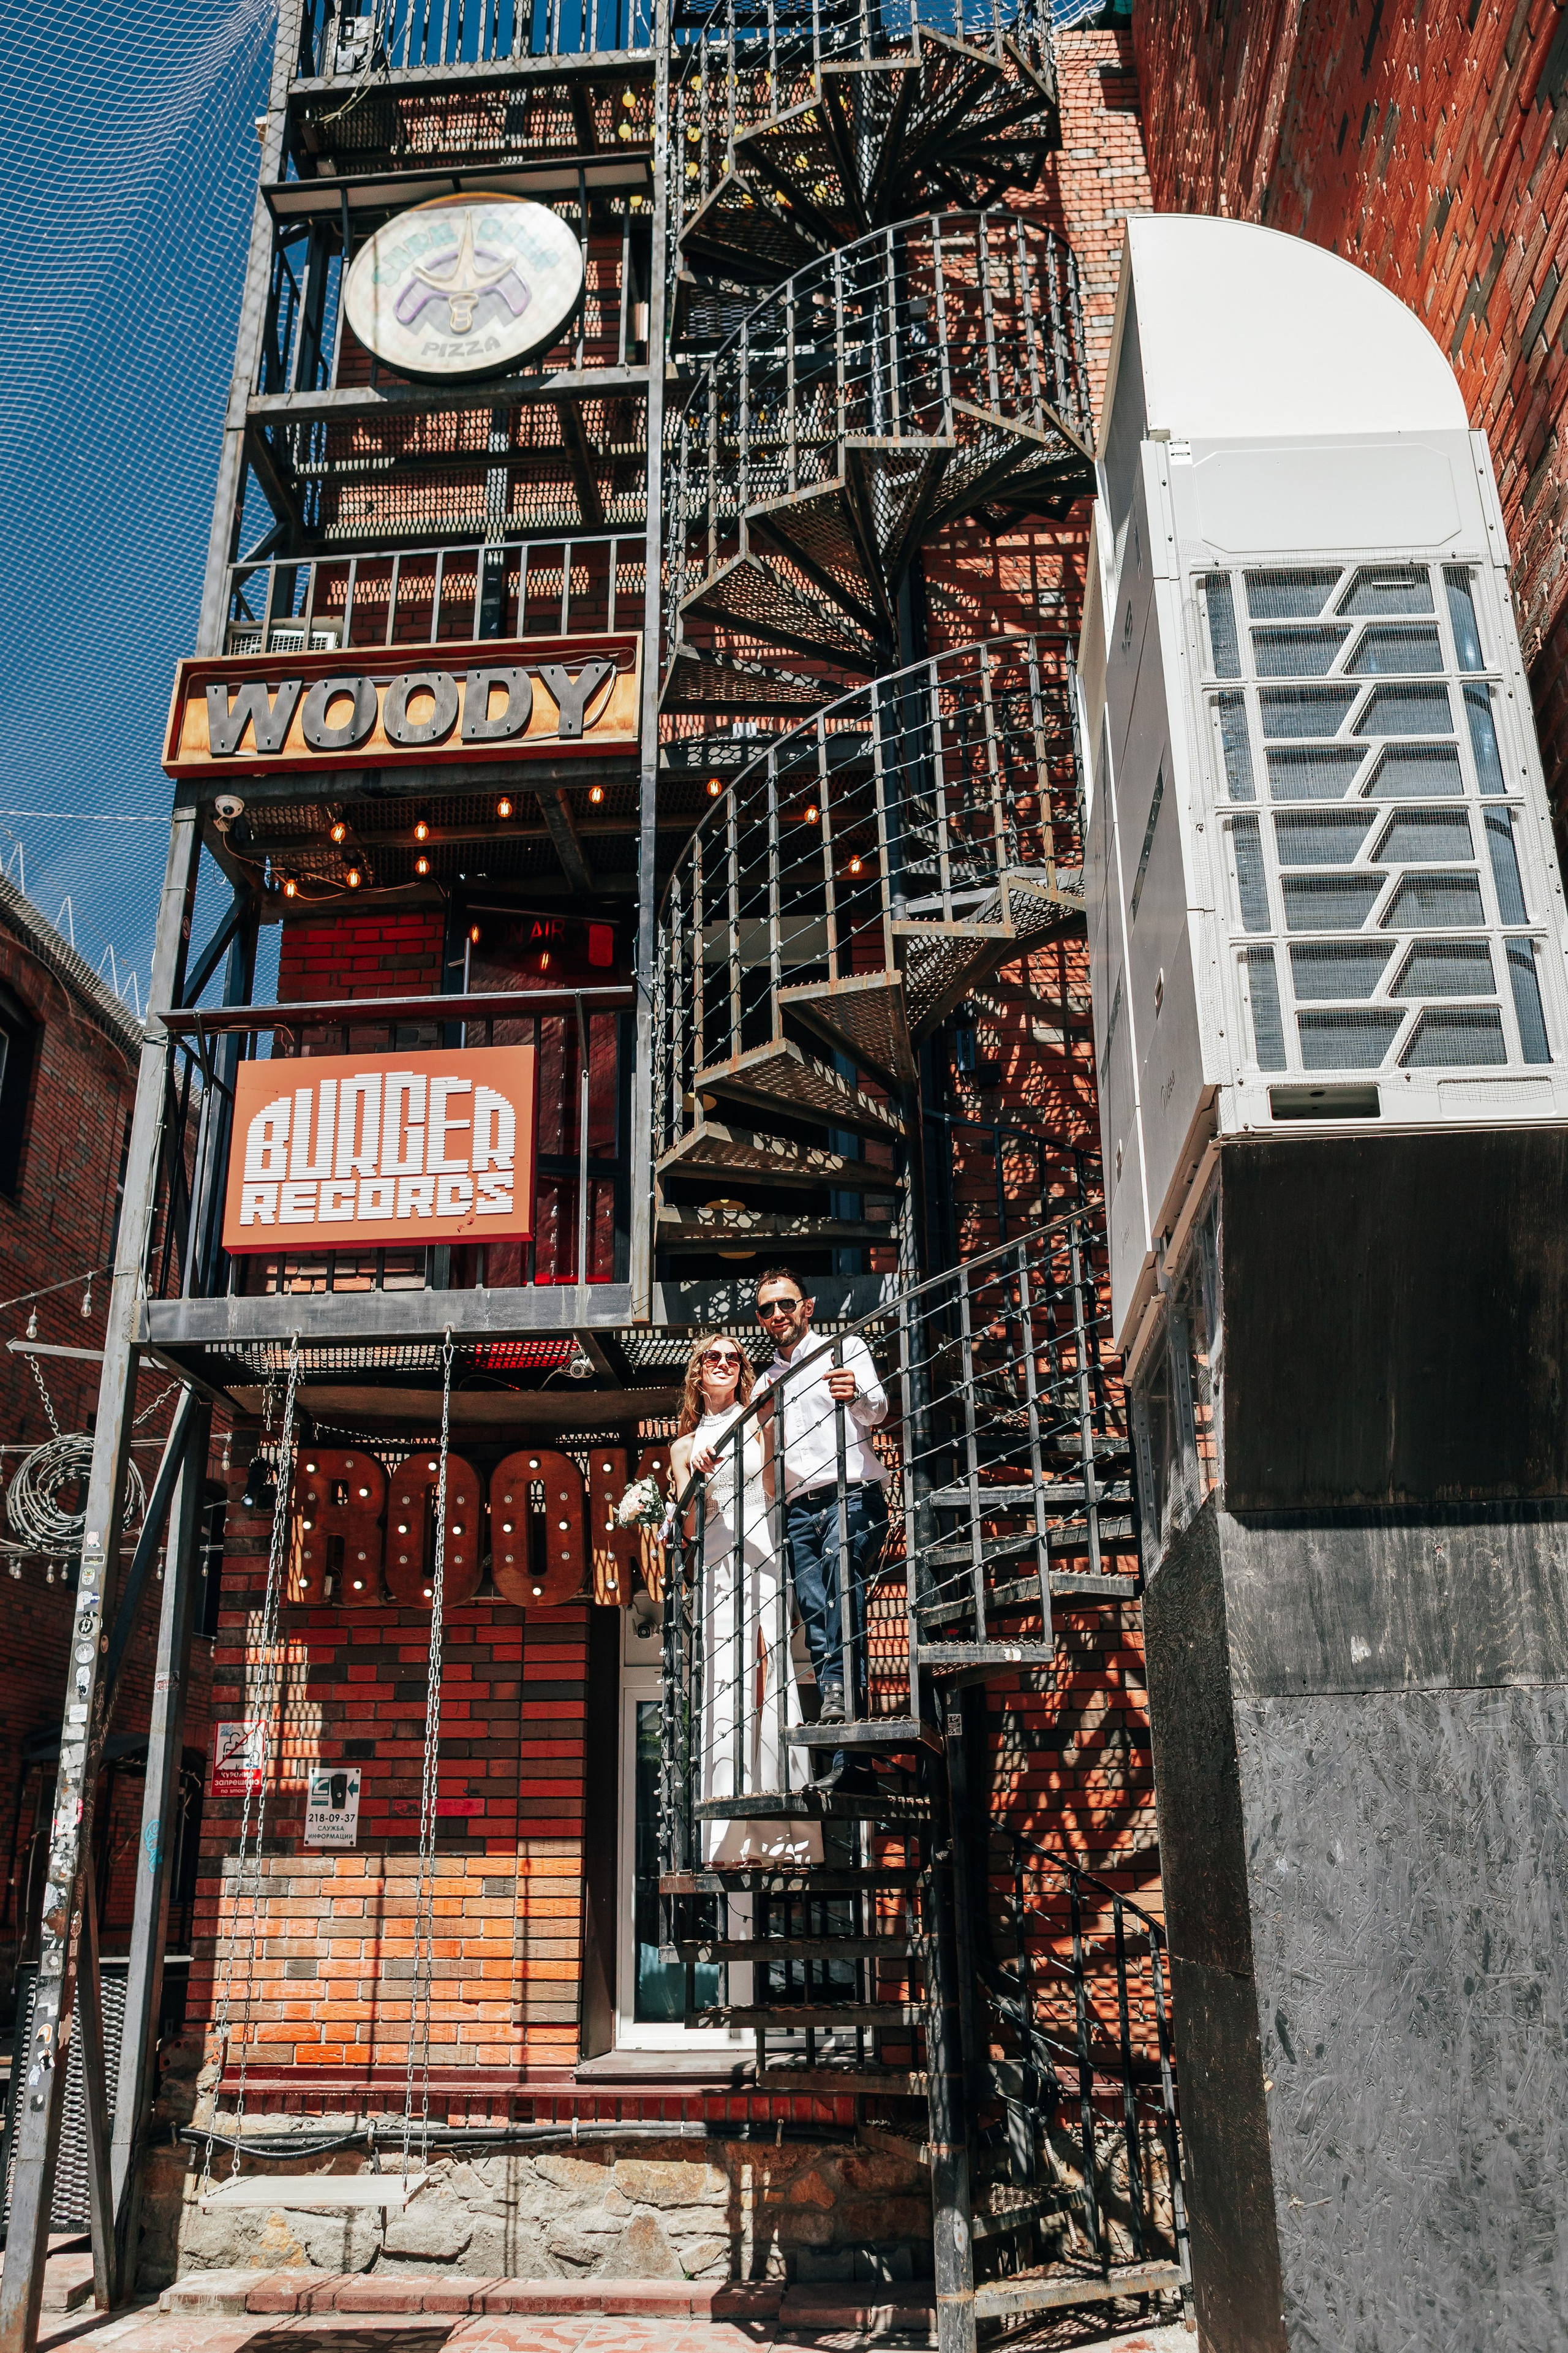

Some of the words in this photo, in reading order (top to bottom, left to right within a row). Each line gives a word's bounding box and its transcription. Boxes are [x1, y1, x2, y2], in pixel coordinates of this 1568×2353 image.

[421, 336, 500, 358] PIZZA
[206, 662, 613, 758] WOODY
[529, 919, 567, 945] AIR
[243, 1071, 516, 1182] BURGER
[239, 1171, 514, 1226] RECORDS
[308, 1814, 355, 1822] 218-09-37
